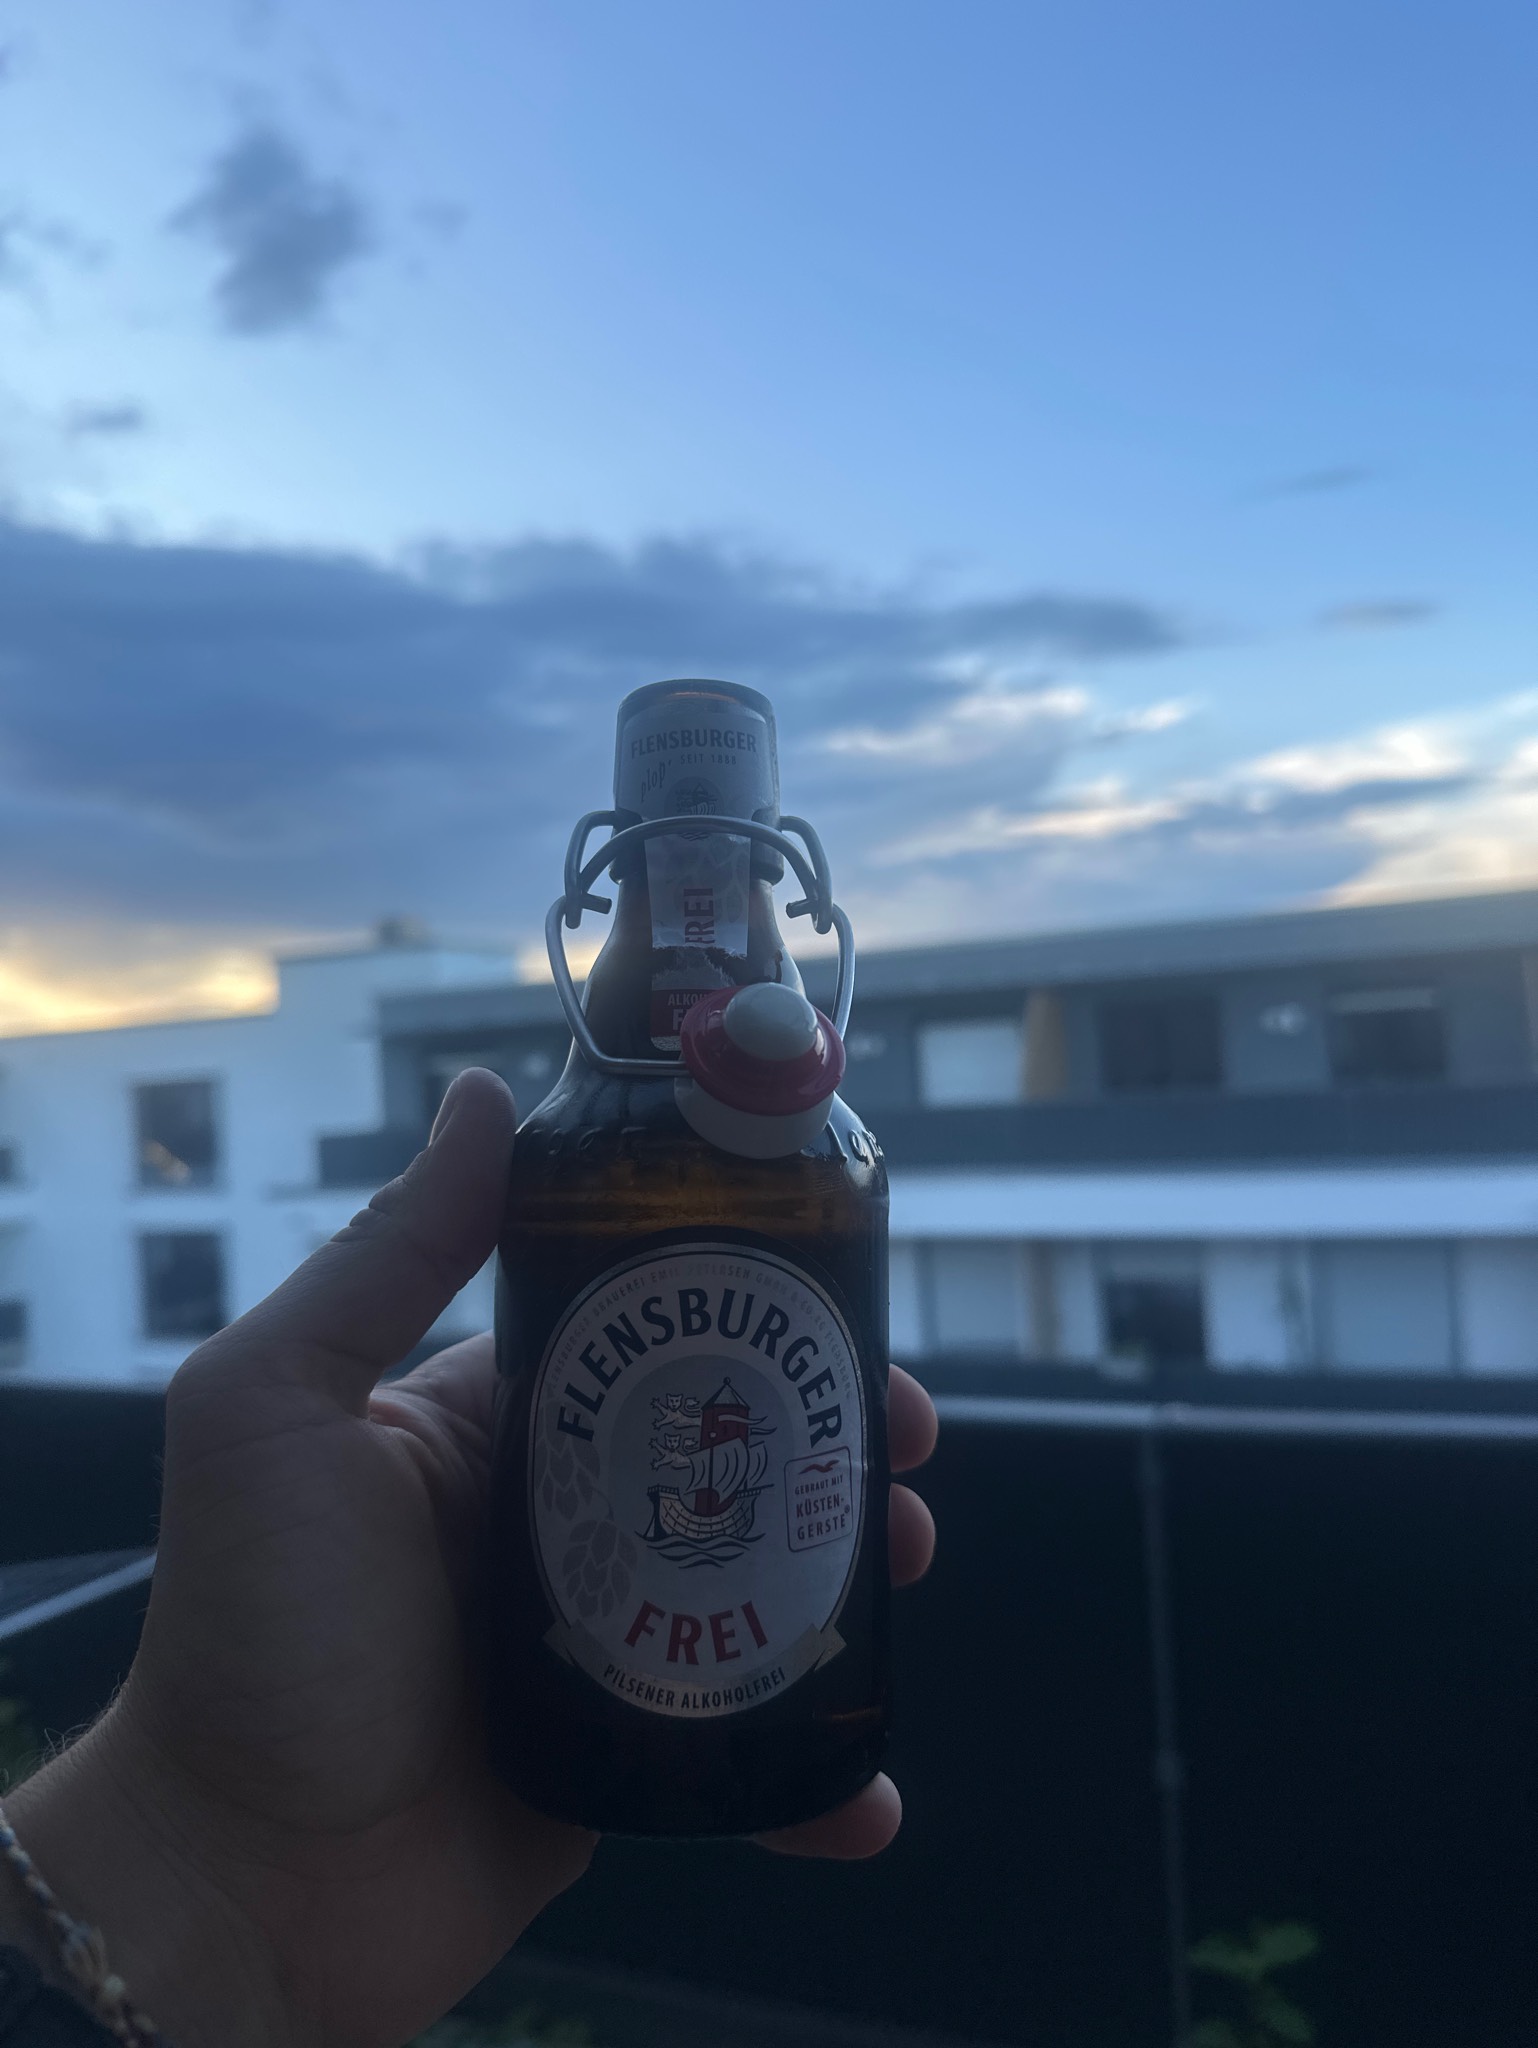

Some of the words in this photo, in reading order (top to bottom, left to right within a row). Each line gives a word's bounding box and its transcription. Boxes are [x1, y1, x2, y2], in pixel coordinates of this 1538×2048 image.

[631, 729, 757, 760] FLENSBURGER
[680, 753, 704, 766] SEIT
[711, 754, 737, 766] 1888
[683, 887, 715, 944] FREI
[557, 1287, 843, 1449] FLENSBURGER
[831, 1473, 843, 1487] MIT
[623, 1599, 769, 1666] FREI
[603, 1663, 676, 1708] PILSENER
[680, 1665, 787, 1710] ALKOHOLFREI
